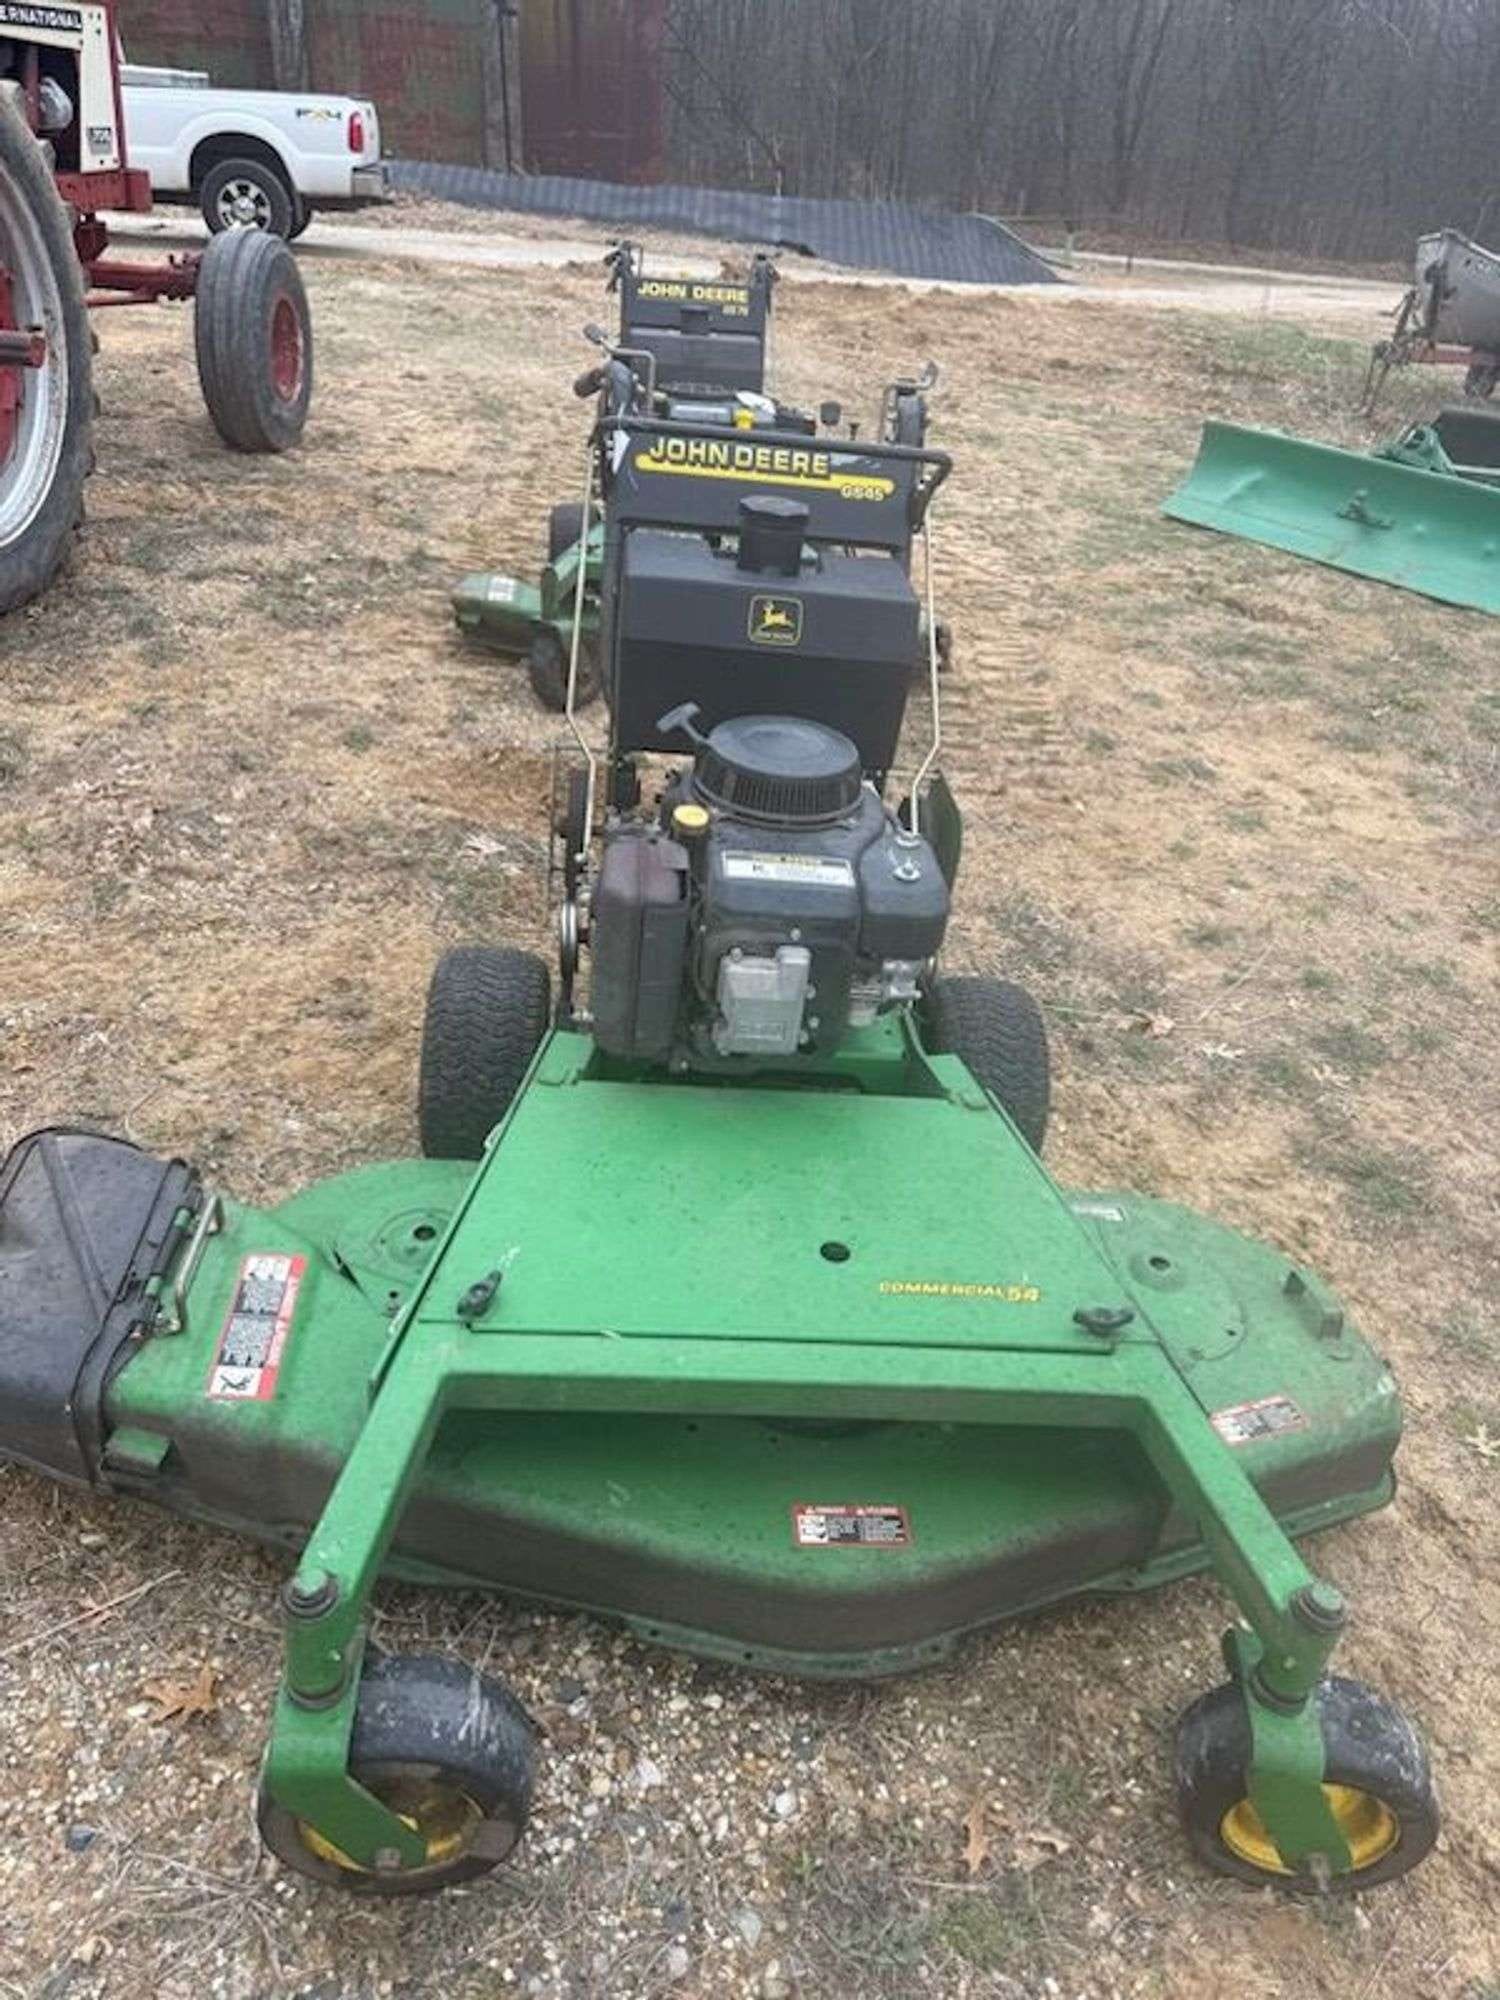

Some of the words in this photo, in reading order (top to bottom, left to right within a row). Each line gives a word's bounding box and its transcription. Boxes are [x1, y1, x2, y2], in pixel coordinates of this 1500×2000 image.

[638, 281, 687, 298] JOHN
[693, 285, 749, 303] DEERE
[650, 437, 728, 466] JOHN
[735, 446, 830, 476] DEERE
[879, 1281, 1006, 1299] COMMERCIAL
